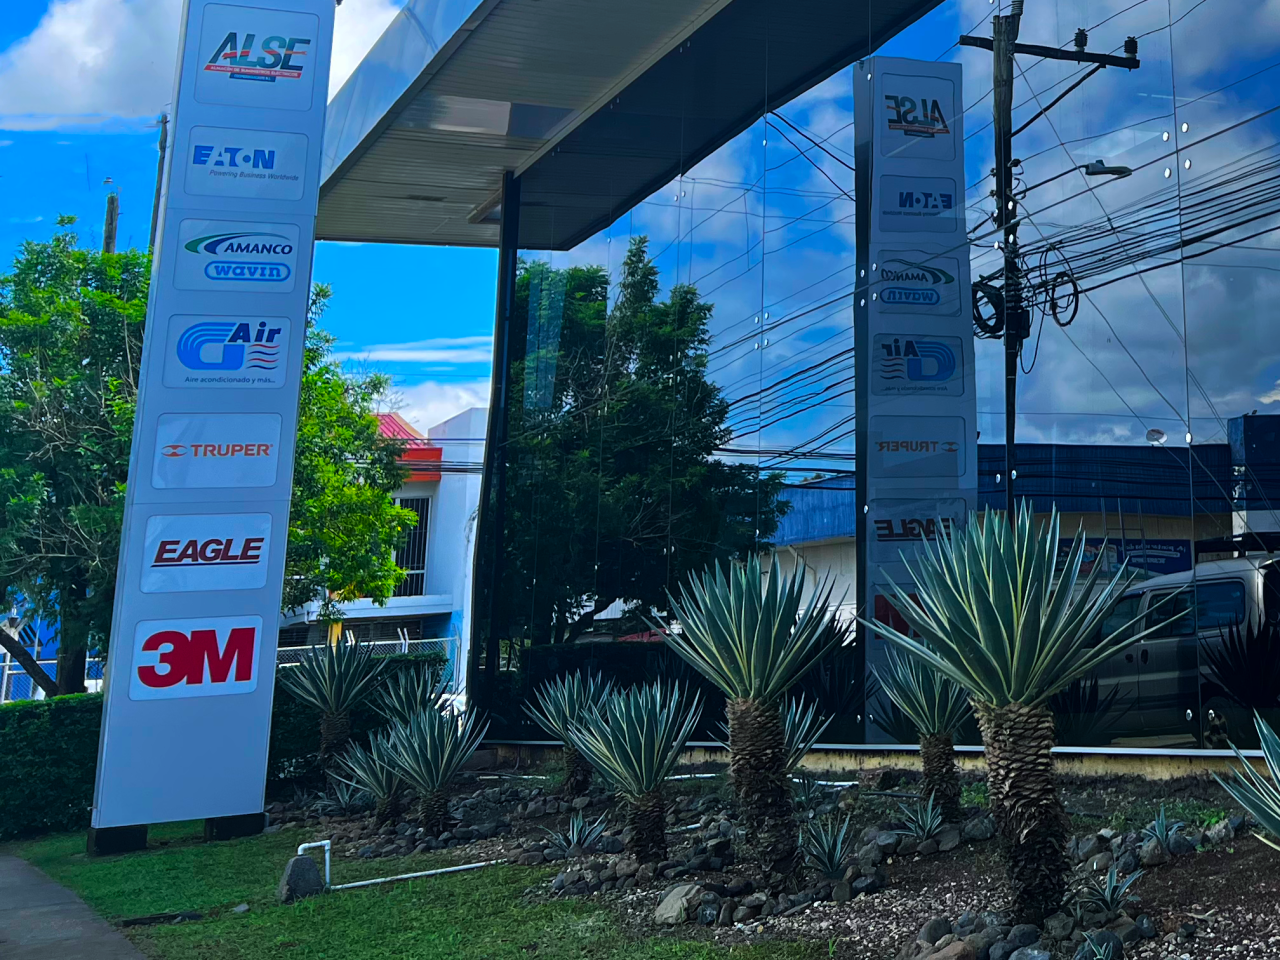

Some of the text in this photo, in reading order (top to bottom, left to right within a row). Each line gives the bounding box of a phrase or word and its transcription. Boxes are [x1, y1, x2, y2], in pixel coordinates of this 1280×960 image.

[208, 31, 311, 71] ALSE
[193, 144, 275, 170] EATON
[209, 169, 299, 181] Powering Business Worldwide
[223, 242, 293, 255] AMANCO
[214, 264, 281, 278] wavin
[153, 537, 264, 563] EAGLE
[137, 626, 256, 689] 3M
